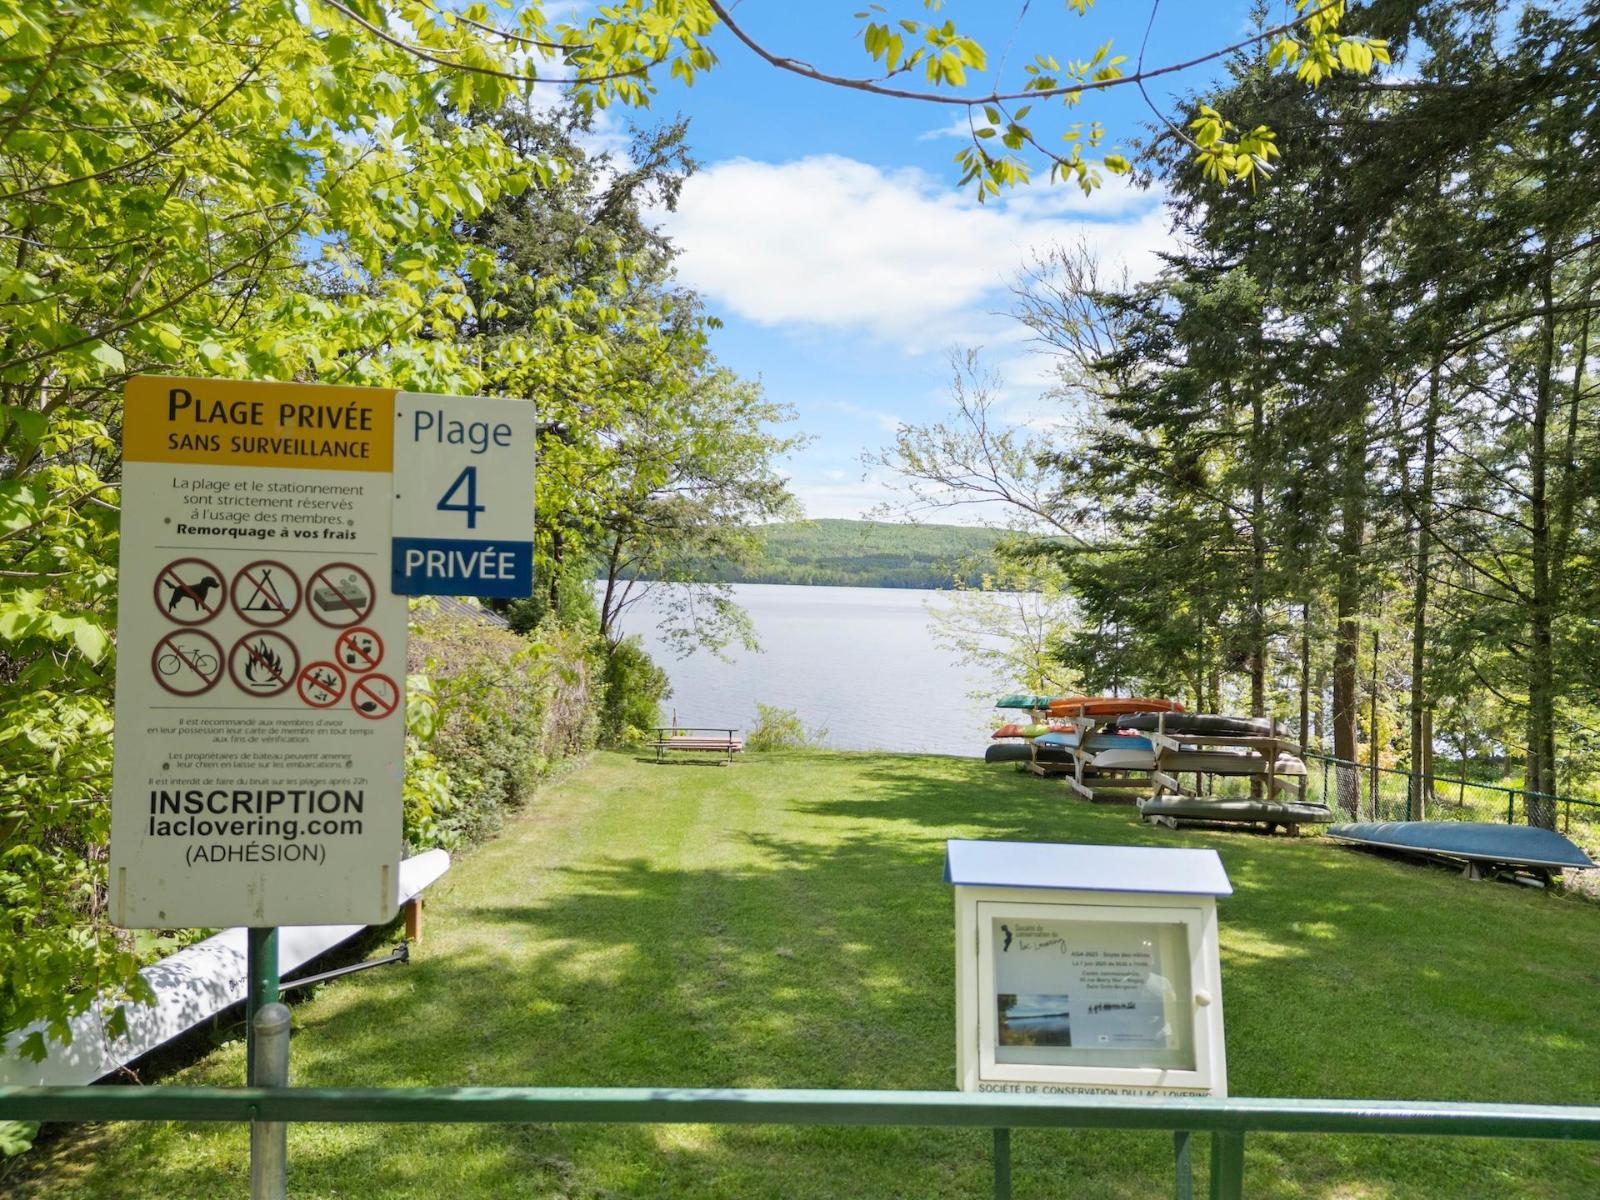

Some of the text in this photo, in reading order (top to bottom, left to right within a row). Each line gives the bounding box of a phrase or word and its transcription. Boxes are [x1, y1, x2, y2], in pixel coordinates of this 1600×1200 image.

[168, 389, 373, 431] PLAGE PRIVÉE
[414, 410, 512, 454] Plage
[168, 433, 369, 459] SANS SURVEILLANCE
[172, 477, 364, 496] La plage et le stationnement
[183, 494, 353, 510] sont strictement réservés
[437, 465, 485, 529] 4
[190, 509, 345, 526] à l'usage des membres.
[176, 523, 357, 540] Remorquage à vos frais
[405, 546, 516, 580] PRIVÉE
[200, 717, 257, 726] recommandé
[276, 719, 314, 727] membres
[179, 728, 224, 737] possession
[226, 727, 242, 735] leur
[268, 727, 280, 735] de
[168, 752, 182, 760] Les
[185, 752, 238, 761] propriétaires
[284, 754, 319, 762] peuvent
[176, 761, 193, 769] leur
[195, 761, 218, 769] chien
[272, 761, 284, 769] les
[170, 777, 200, 785] interdit
[202, 777, 214, 785] de
[216, 777, 234, 785] faire
[236, 777, 248, 785] du
[250, 777, 270, 785] bruit
[299, 778, 326, 787] plages
[150, 790, 364, 814] INSCRIPTION
[149, 816, 363, 840] laclovering.com
[186, 841, 326, 867] (ADHÉSION)
[1025, 1085, 1039, 1094] DE
[1042, 1086, 1118, 1096] CONSERVATION
